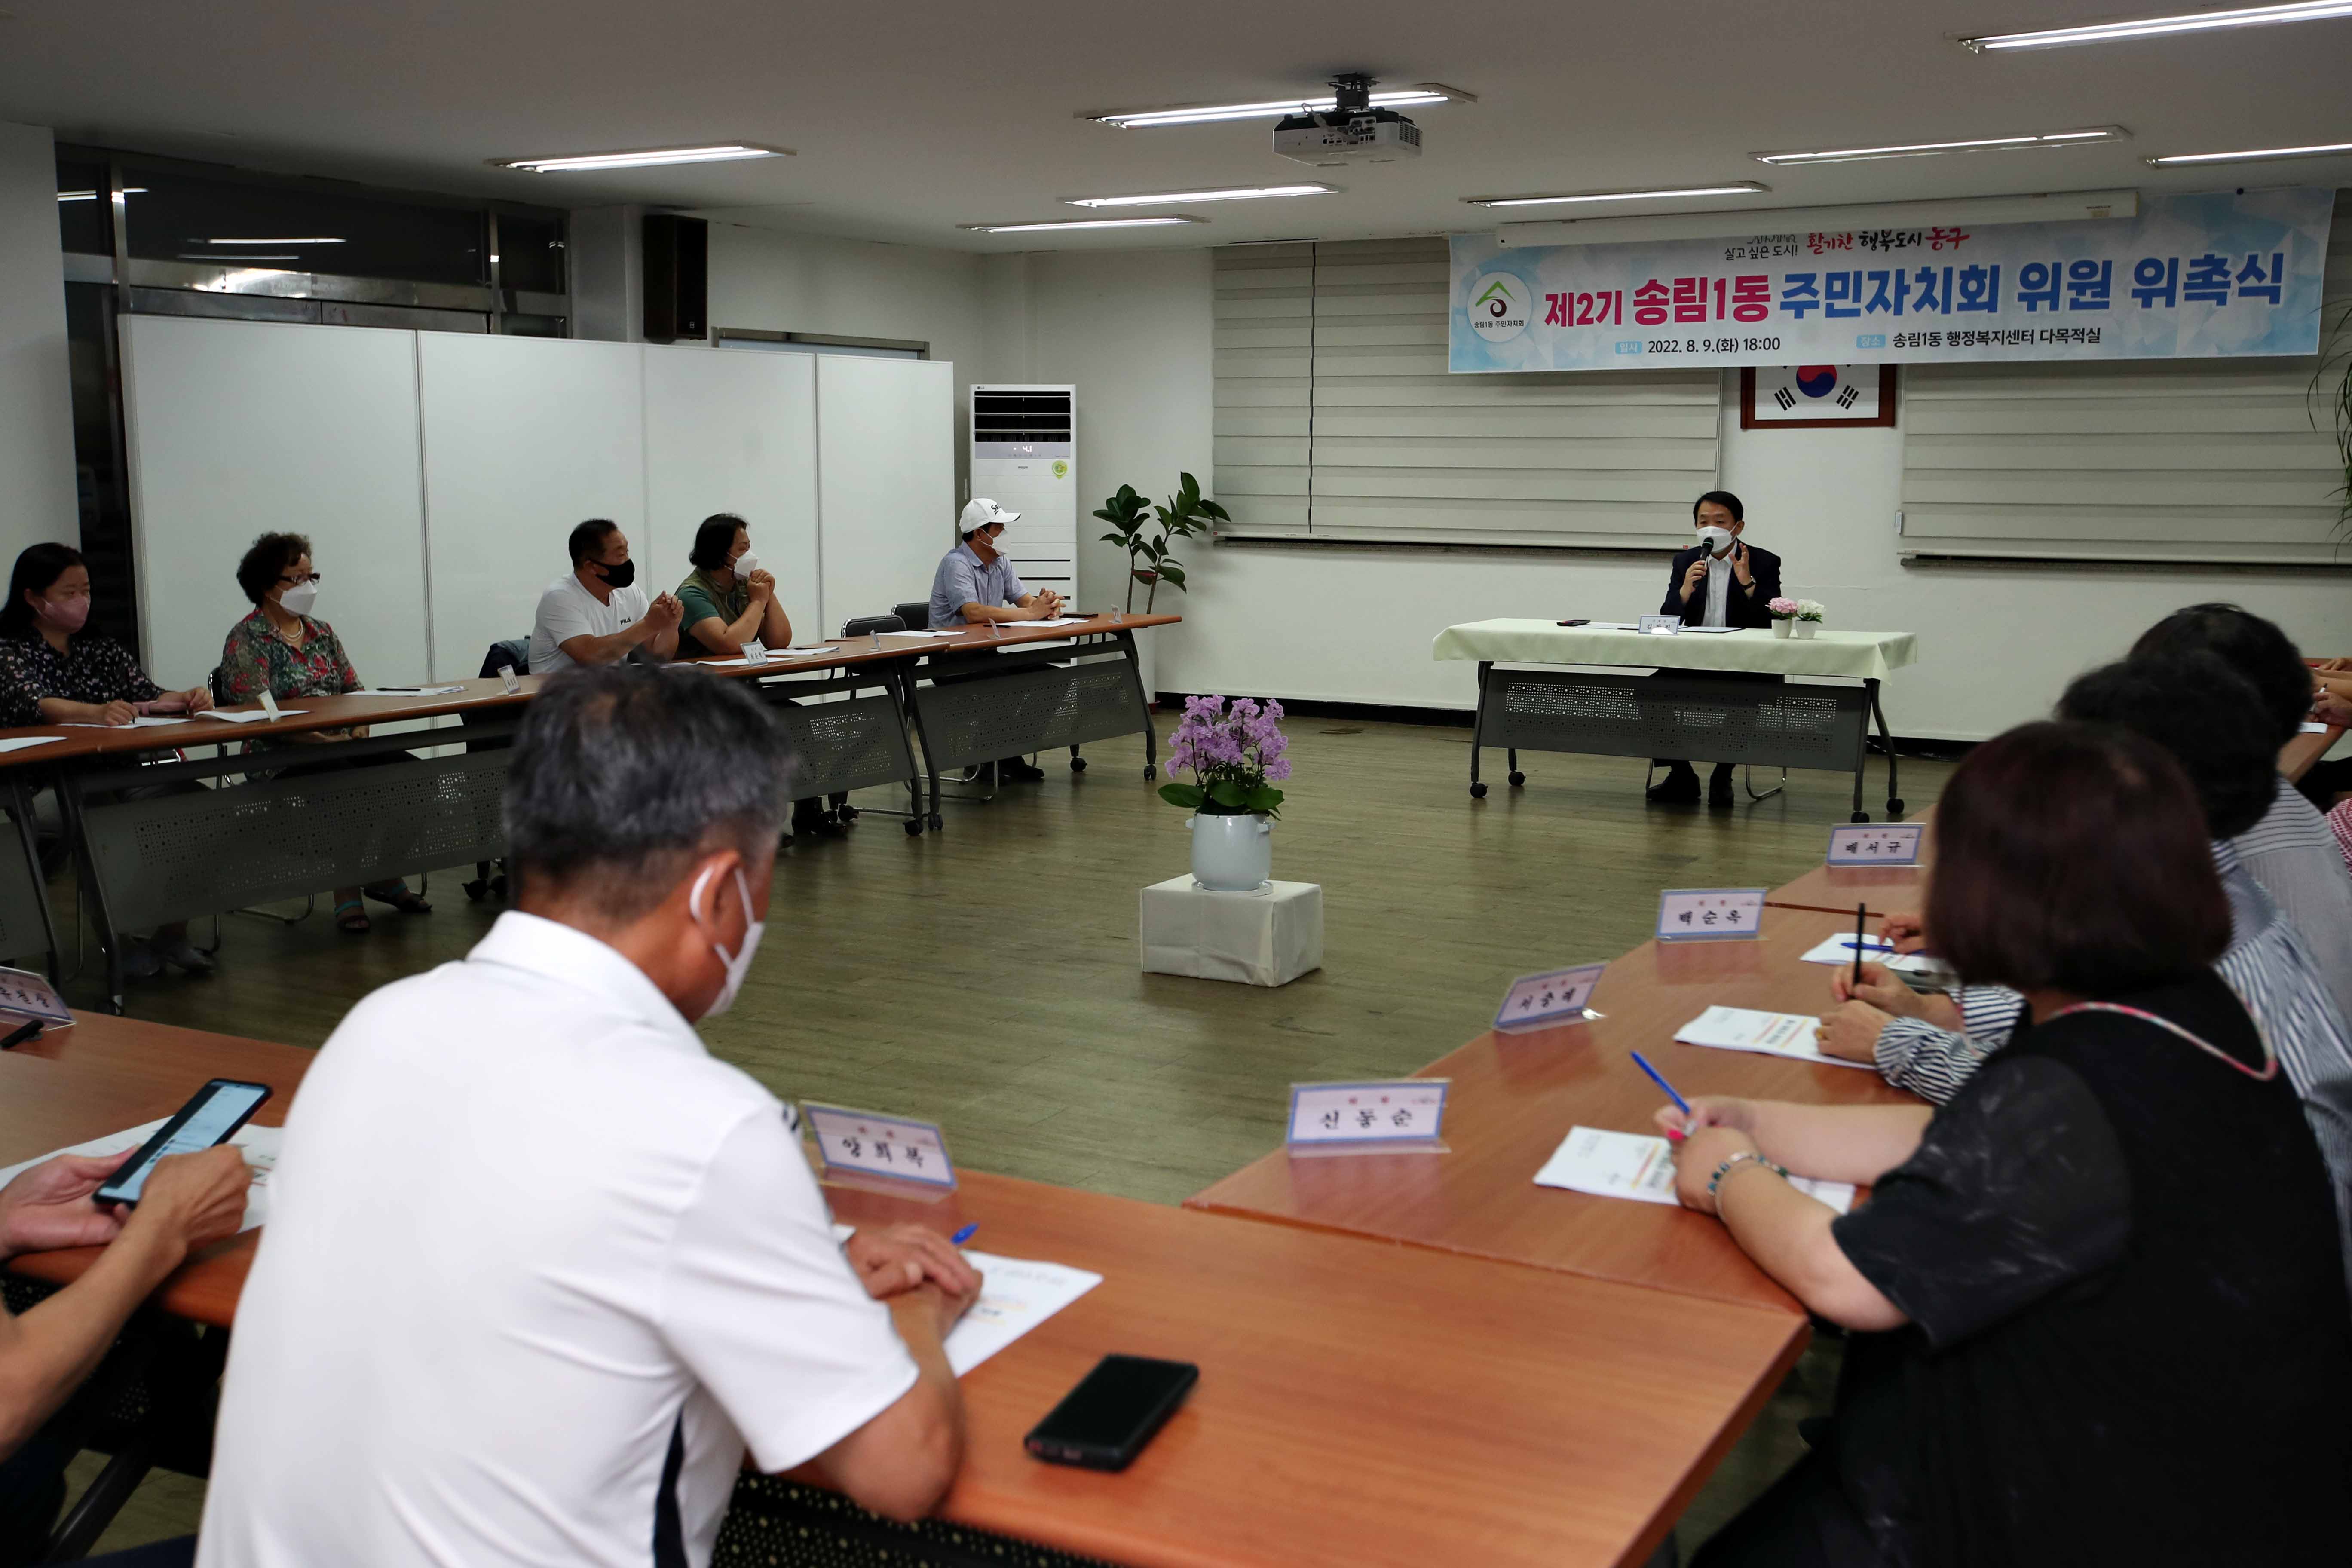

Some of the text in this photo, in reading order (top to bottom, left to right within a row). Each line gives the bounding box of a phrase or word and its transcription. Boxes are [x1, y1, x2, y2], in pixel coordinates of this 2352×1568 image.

[1807, 232, 1854, 255] 활기찬
[1858, 229, 1922, 252] 행복도시
[1724, 244, 1798, 261] 살고 싶은 도시!
[1544, 253, 2285, 328] 제2기 송림1동 주민자치회 위원 위촉식
[1648, 340, 1682, 353] 2022.
[1686, 340, 1699, 352] 8.
[1743, 337, 1781, 351] 18:00
[1892, 328, 2101, 348] 송림1동 행정복지센터 다목적실
